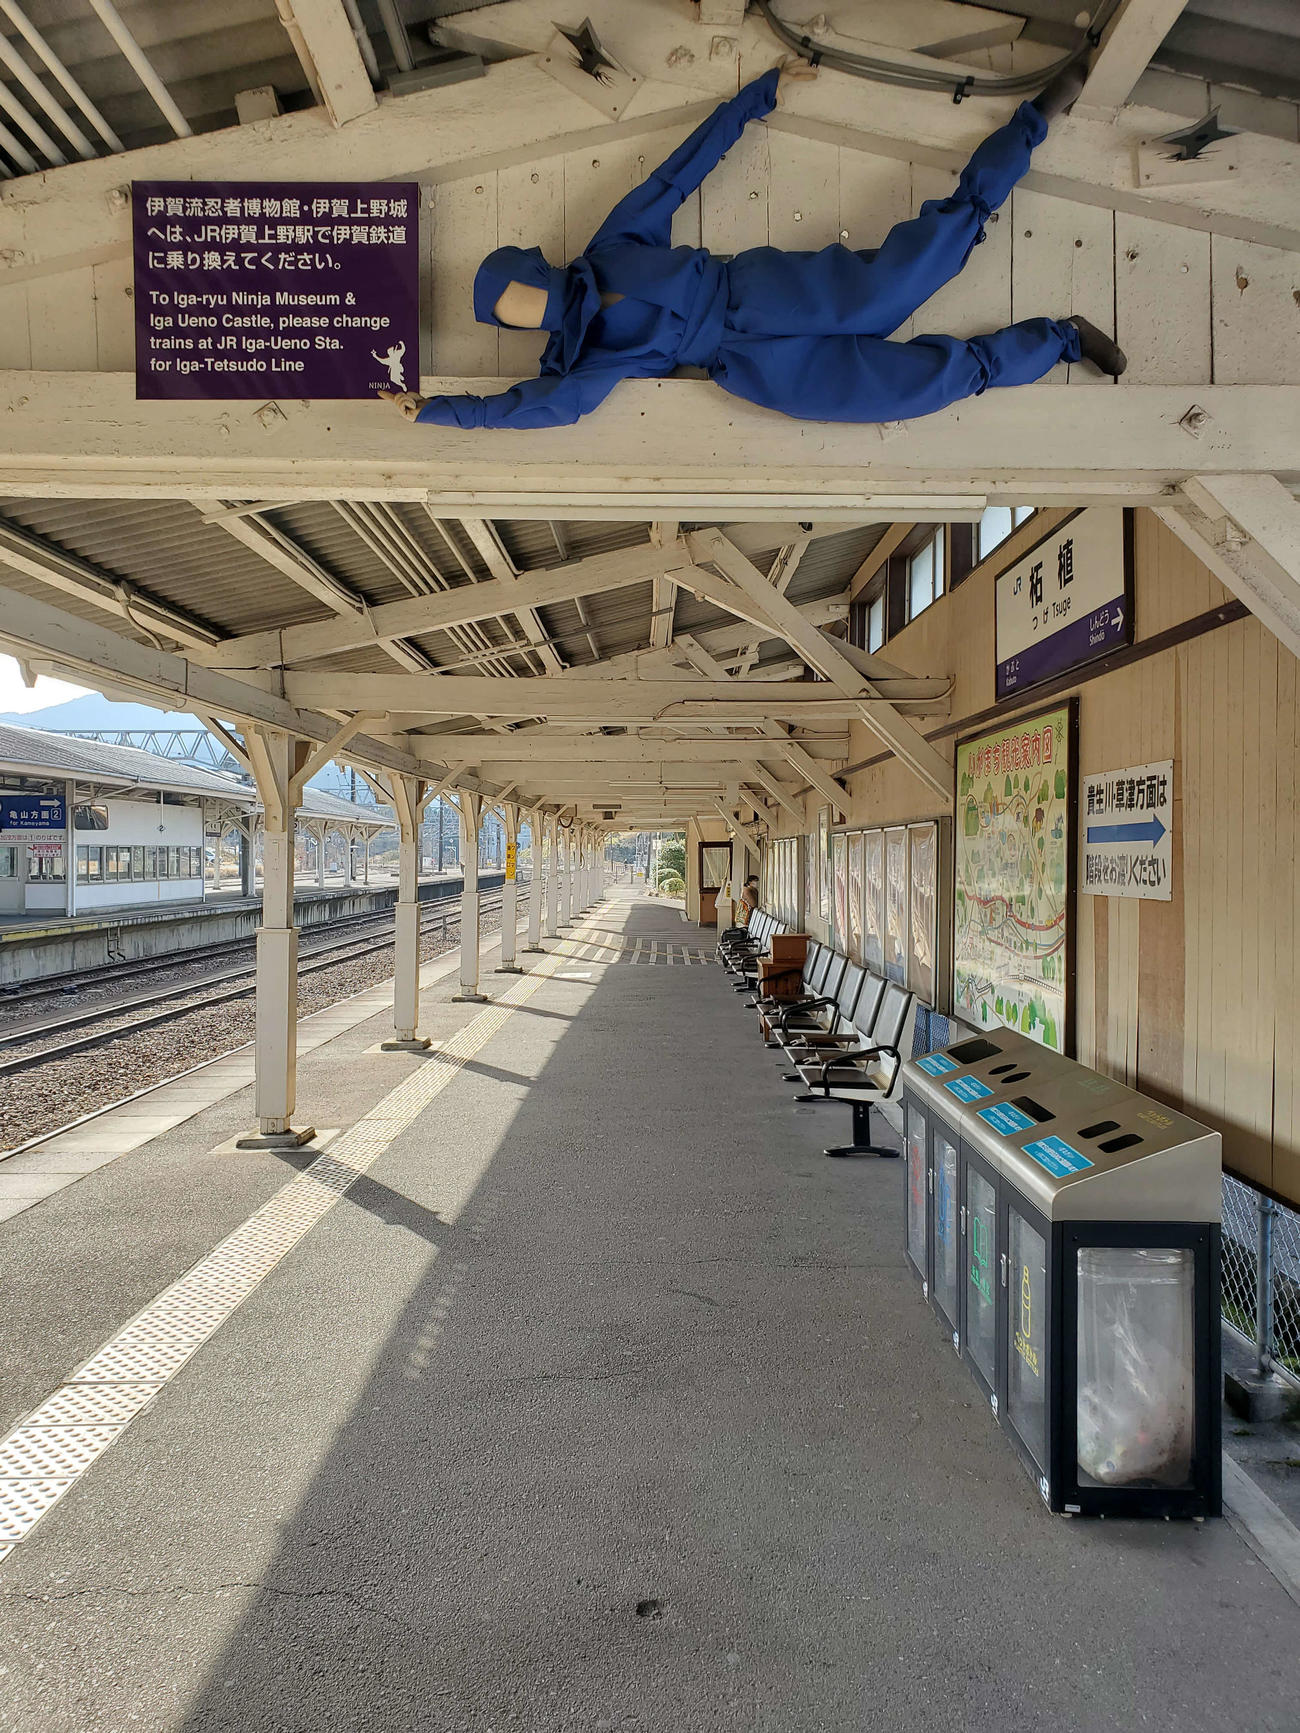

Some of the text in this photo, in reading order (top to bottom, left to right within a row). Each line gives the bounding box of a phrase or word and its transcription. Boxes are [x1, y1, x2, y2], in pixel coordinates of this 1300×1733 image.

[146, 197, 408, 218] 伊賀流忍者博物館・伊賀上野城
[147, 224, 407, 245] へは、JR伊賀上野駅で伊賀鉄道
[148, 251, 342, 270] に乗り換えてください。
[149, 291, 356, 309] To Iga-ryu Ninja Museum &
[150, 314, 390, 330] Iga Ueno Castle, please change
[150, 336, 344, 353] trains at JR Iga-Ueno Sta.
[150, 358, 305, 374] for Iga-Tetsudo Line
[368, 382, 391, 390] NINJA
[1013, 539, 1074, 607] JR 柘植
[1032, 596, 1071, 630] つげ Tsuge
[1089, 610, 1109, 631] しんどう
[53, 810, 59, 819] 2
